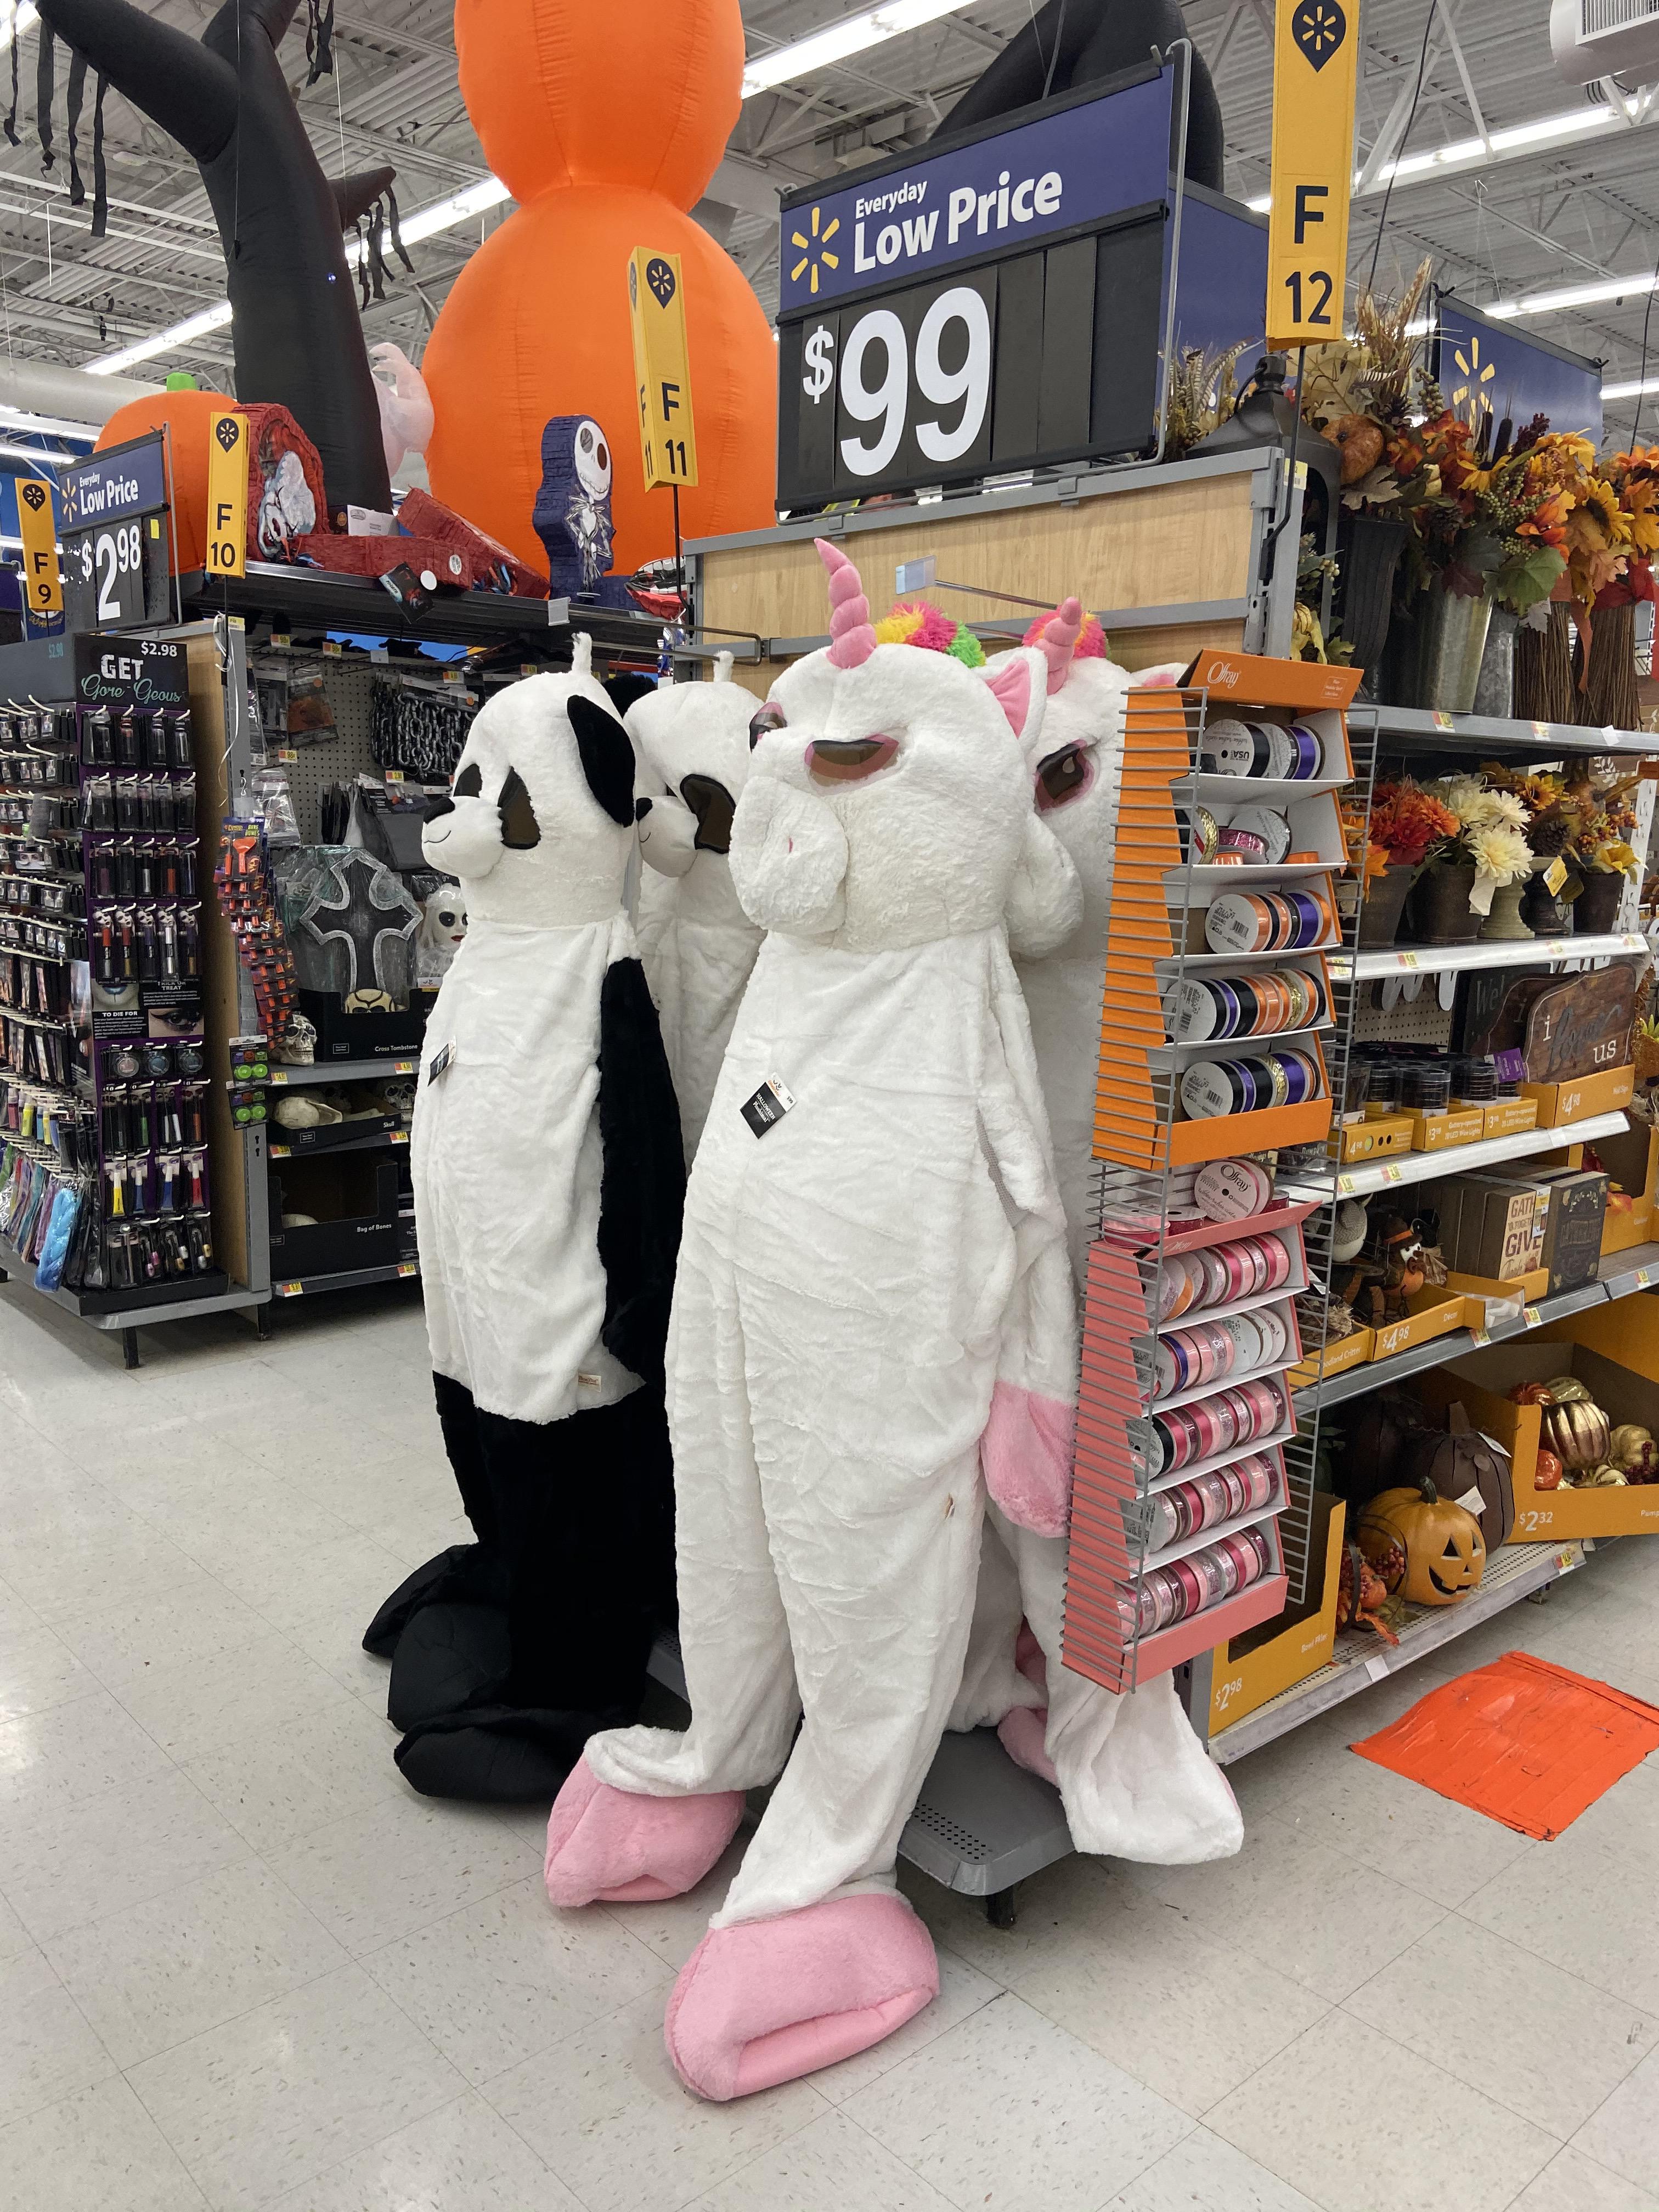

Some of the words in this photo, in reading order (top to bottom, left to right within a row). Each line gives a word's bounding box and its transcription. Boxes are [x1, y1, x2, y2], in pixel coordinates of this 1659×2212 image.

[855, 179, 928, 219] Everyday
[854, 211, 939, 274] Low
[947, 171, 1063, 245] Price
[1294, 185, 1329, 244] F
[1285, 270, 1333, 325] 12
[802, 286, 992, 477] $99
[640, 383, 646, 428] F
[662, 382, 680, 421] F
[645, 440, 653, 479] 11
[665, 439, 687, 476] 11
[80, 472, 100, 488] Everyday
[80, 487, 105, 516] Low
[106, 475, 138, 508] Price
[217, 504, 233, 531] F
[34, 552, 48, 574] F
[211, 541, 235, 568] 10
[38, 584, 52, 603] 9
[140, 641, 178, 658] $2.98
[100, 654, 144, 681] GET
[133, 678, 182, 704] Geous
[1234, 750, 1249, 759] USA
[1543, 1015, 1551, 1041] i
[1593, 1040, 1616, 1063] us
[756, 1093, 775, 1120] HALLOWEEN
[1220, 1164, 1249, 1192] Offray
[1505, 1230, 1542, 1257] GIVE
